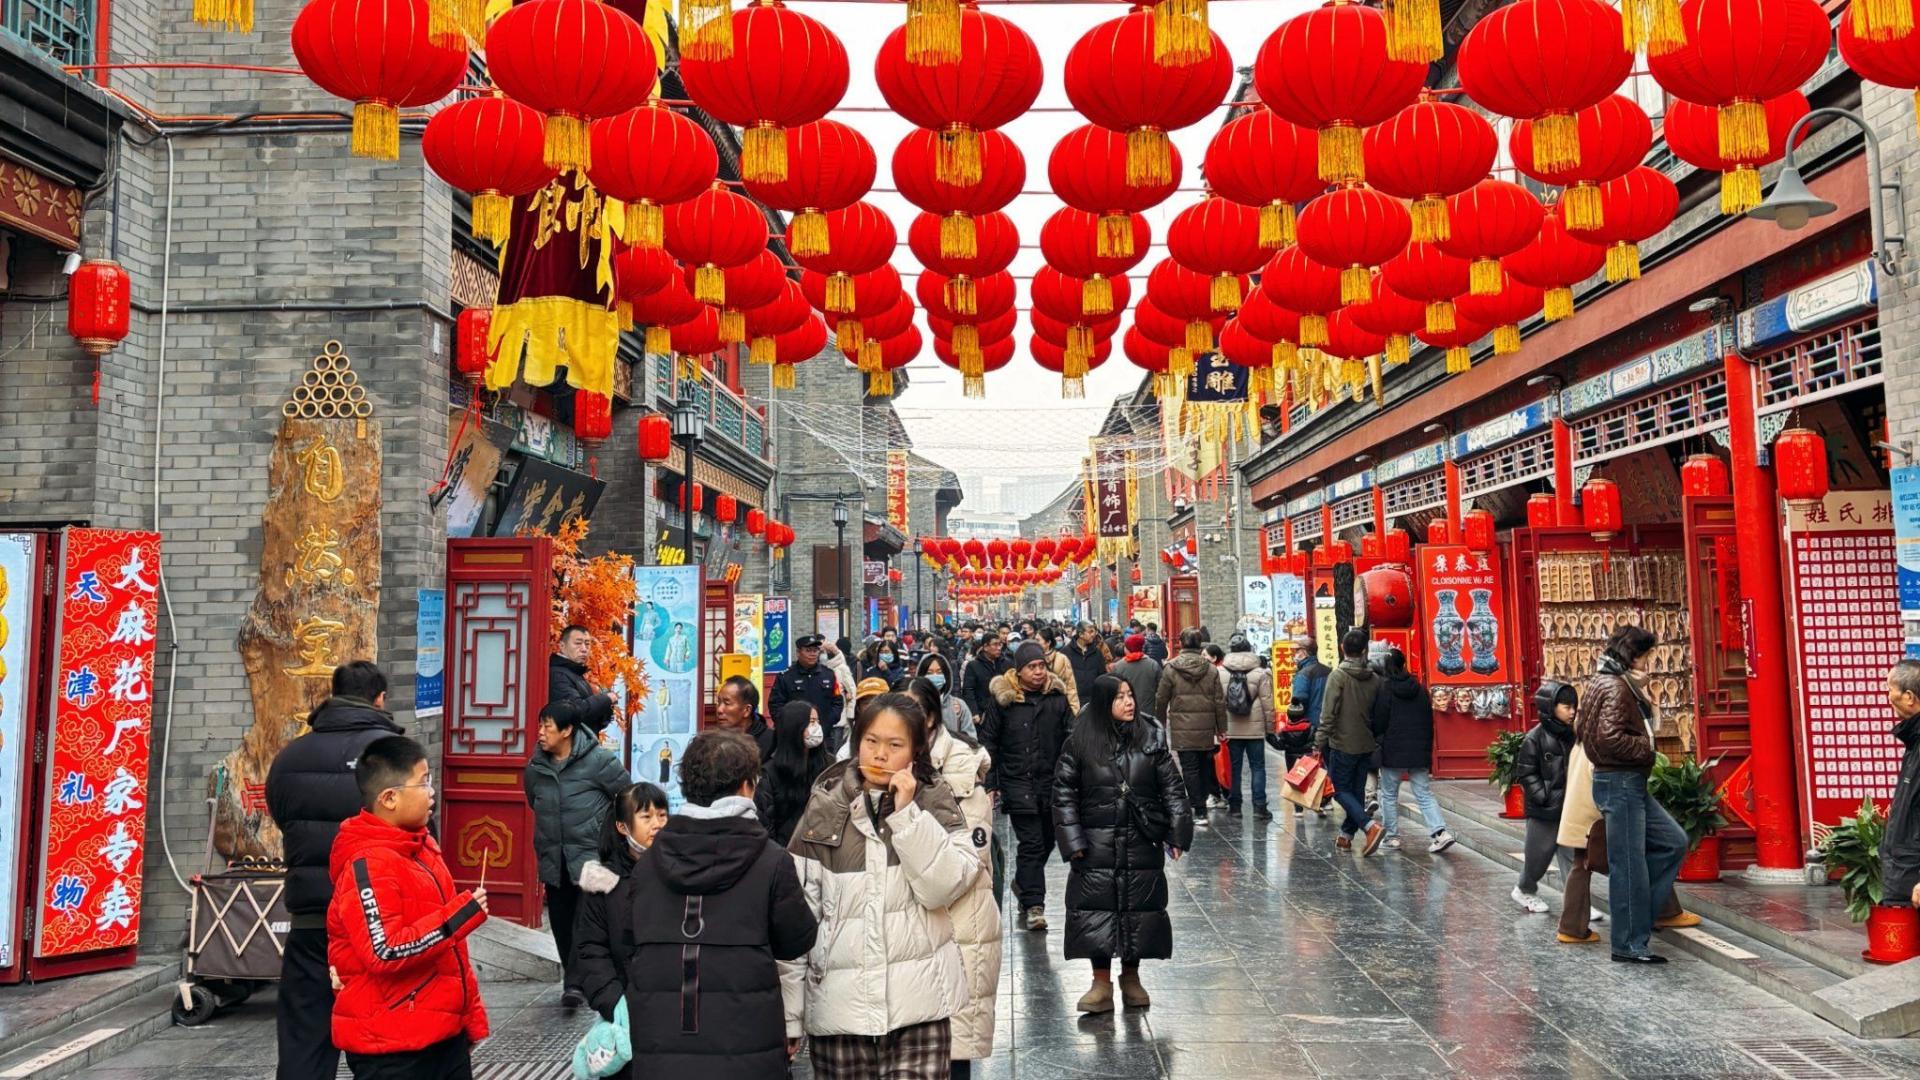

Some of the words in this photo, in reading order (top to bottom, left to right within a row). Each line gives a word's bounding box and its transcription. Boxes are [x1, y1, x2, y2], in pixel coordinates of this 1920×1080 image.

[52, 570, 106, 913] 天津礼物
[97, 547, 156, 931] 大麻花厂家专卖
